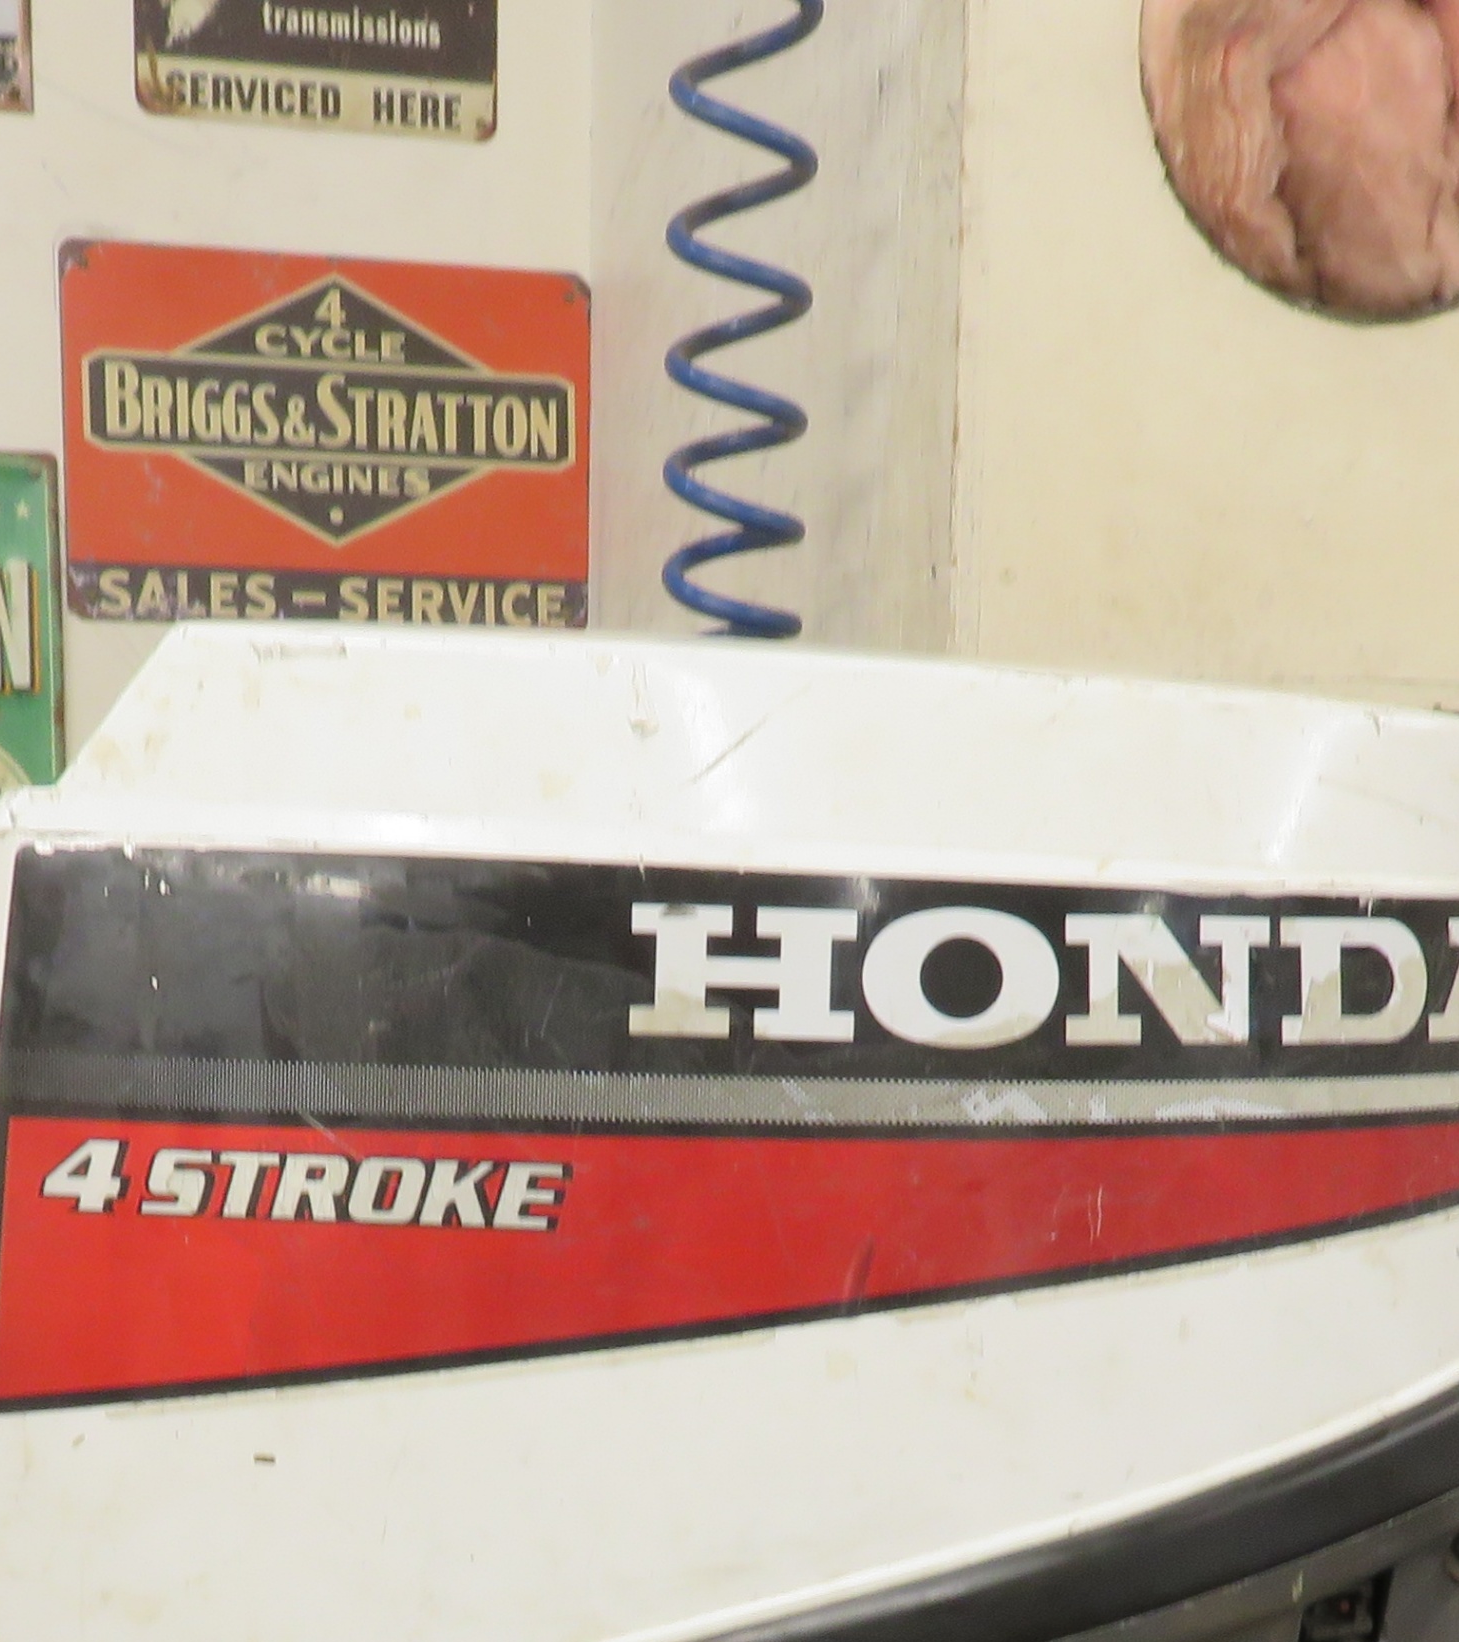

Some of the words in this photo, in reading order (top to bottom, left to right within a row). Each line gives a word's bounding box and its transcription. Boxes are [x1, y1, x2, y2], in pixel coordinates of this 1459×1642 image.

[262, 1, 442, 51] transmissions
[165, 69, 341, 121] SERVICED
[373, 87, 462, 132] HERE
[314, 288, 345, 327] 4
[254, 325, 405, 363] CYCLE
[243, 459, 430, 498] ENGINES
[98, 567, 277, 619] SALES
[340, 575, 568, 628] SERVICE
[42, 1137, 130, 1215] 4
[140, 1146, 573, 1232] STROKE
